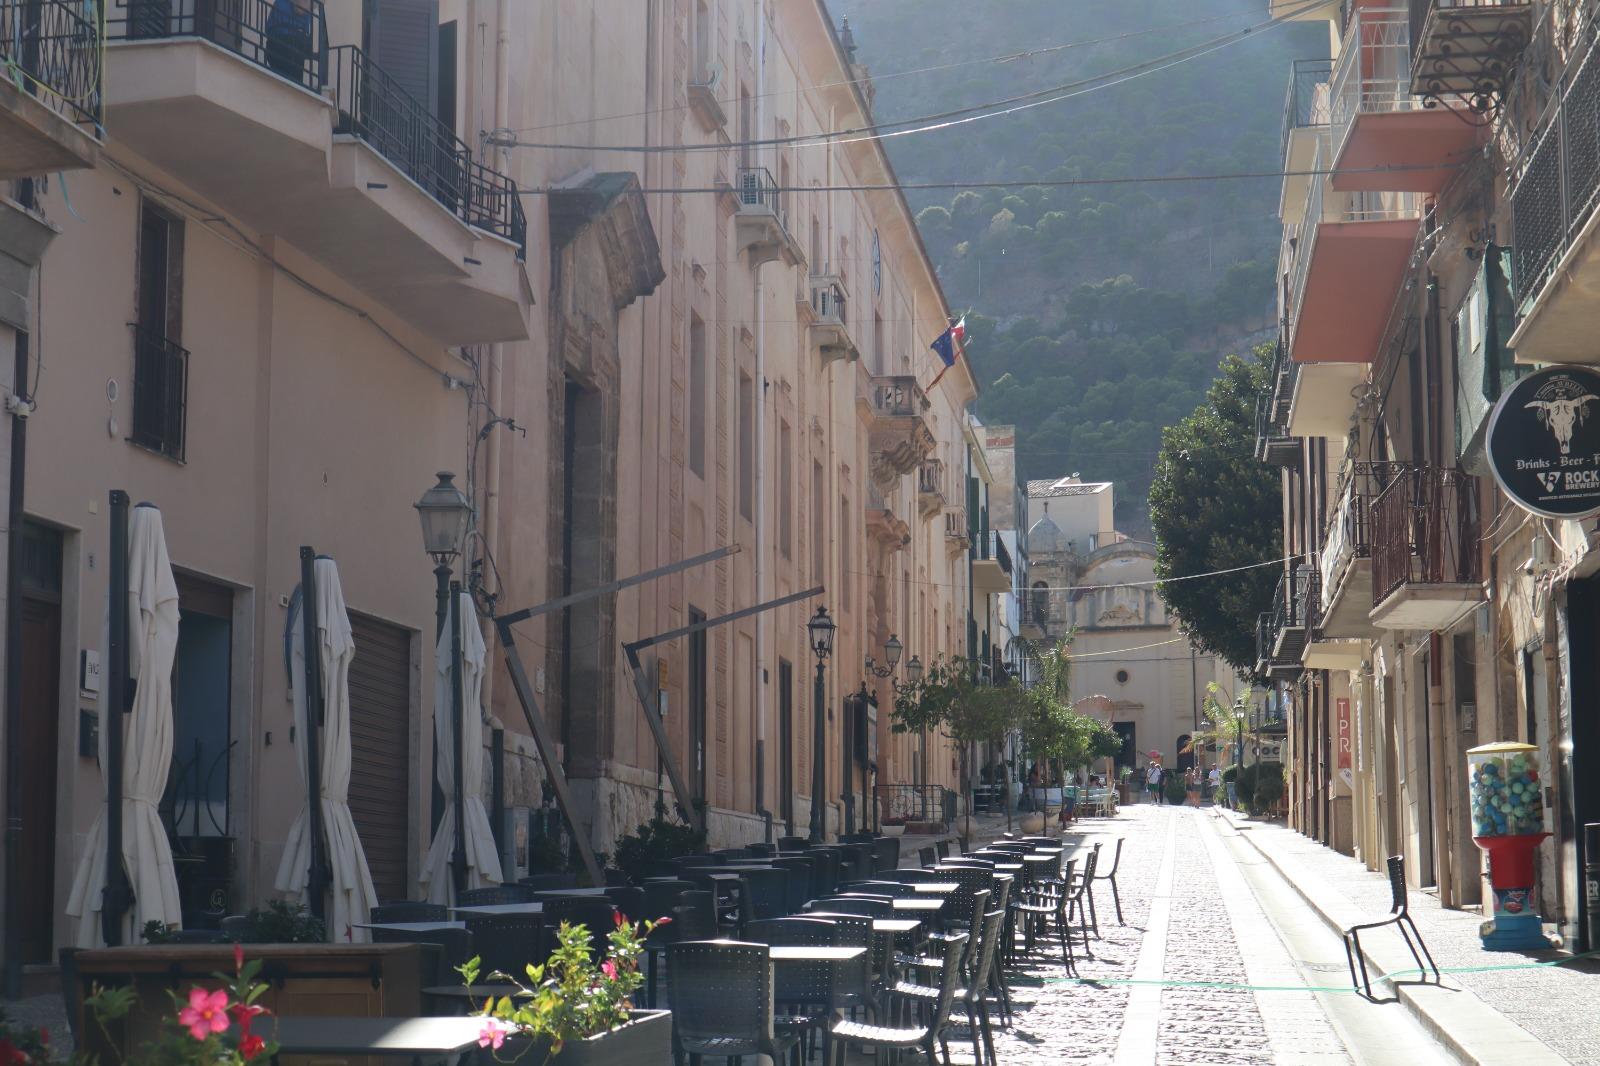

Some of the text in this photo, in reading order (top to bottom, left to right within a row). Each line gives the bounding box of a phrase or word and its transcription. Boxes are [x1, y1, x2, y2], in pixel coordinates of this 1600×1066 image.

[1516, 459, 1550, 469] Drinks
[1560, 456, 1584, 466] Beer
[1565, 470, 1599, 483] ROCK
[1565, 482, 1600, 491] BREWERY
